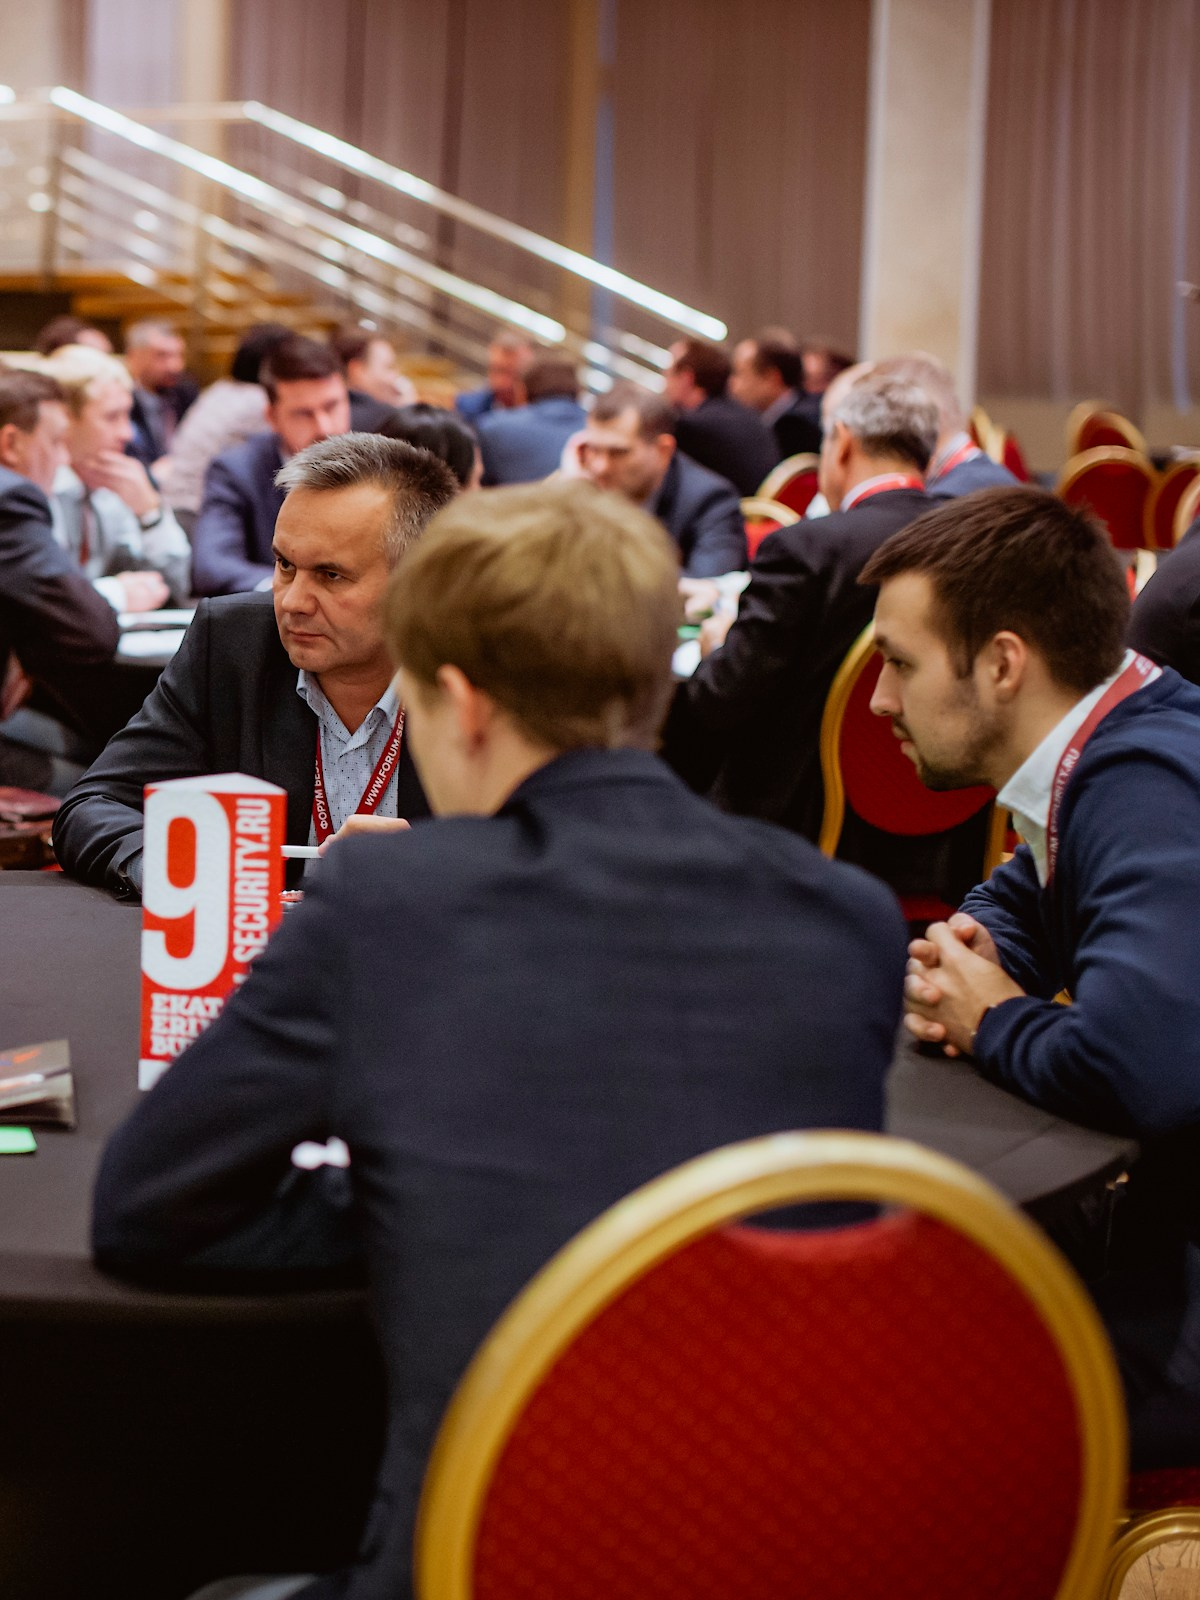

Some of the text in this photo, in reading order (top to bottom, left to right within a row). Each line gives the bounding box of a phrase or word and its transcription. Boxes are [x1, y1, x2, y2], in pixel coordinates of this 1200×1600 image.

[314, 789, 329, 830] ФОРУМ
[141, 789, 232, 990] 9
[150, 993, 225, 1019] EKAT
